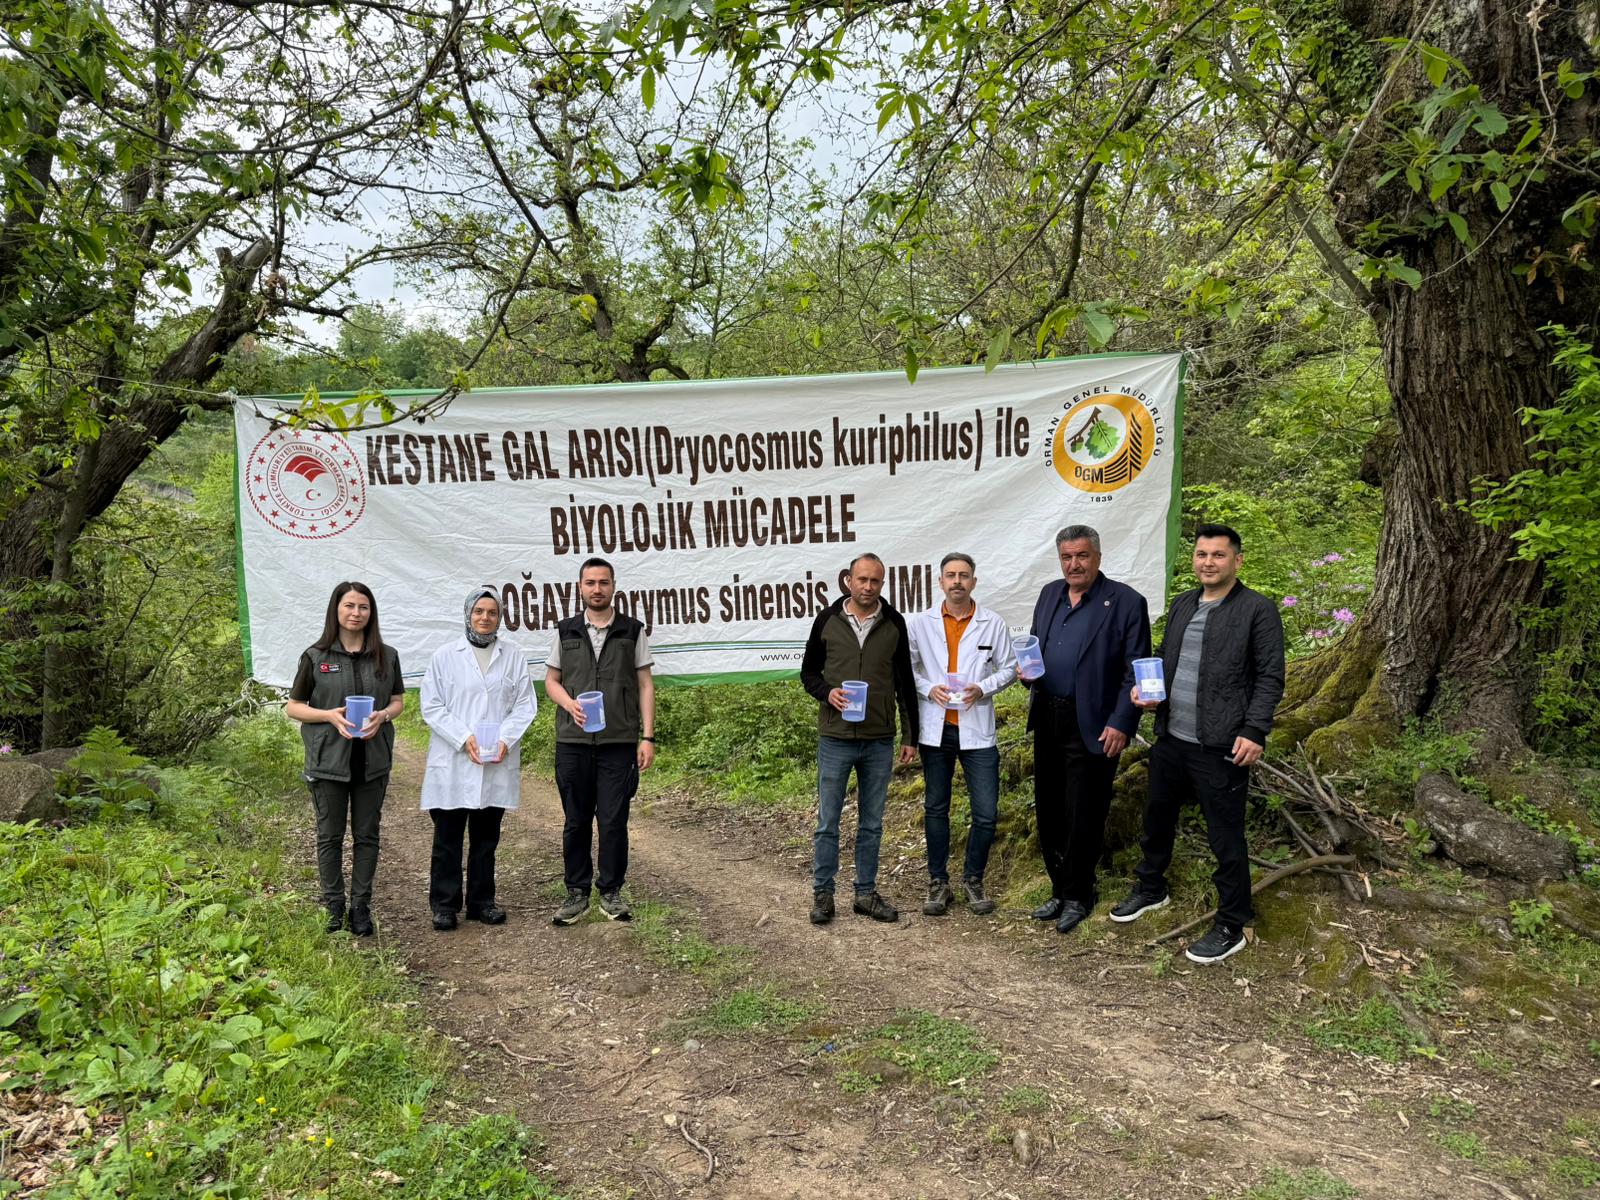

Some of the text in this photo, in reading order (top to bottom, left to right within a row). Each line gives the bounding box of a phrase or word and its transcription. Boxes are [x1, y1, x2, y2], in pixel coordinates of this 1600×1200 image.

[315, 449, 325, 459] VE
[365, 407, 1030, 488] KESTANE GAL ARISI(Dryocosmus kuriphilus) ile
[1044, 417, 1060, 467] ORMAN
[1063, 385, 1110, 410] GENEL
[1074, 465, 1104, 484] OGM
[1090, 495, 1113, 503] 1839
[549, 487, 857, 556] BİYOLOJİK MÜCADELE
[481, 571, 586, 632] OĞAY
[719, 570, 829, 623] sinensis
